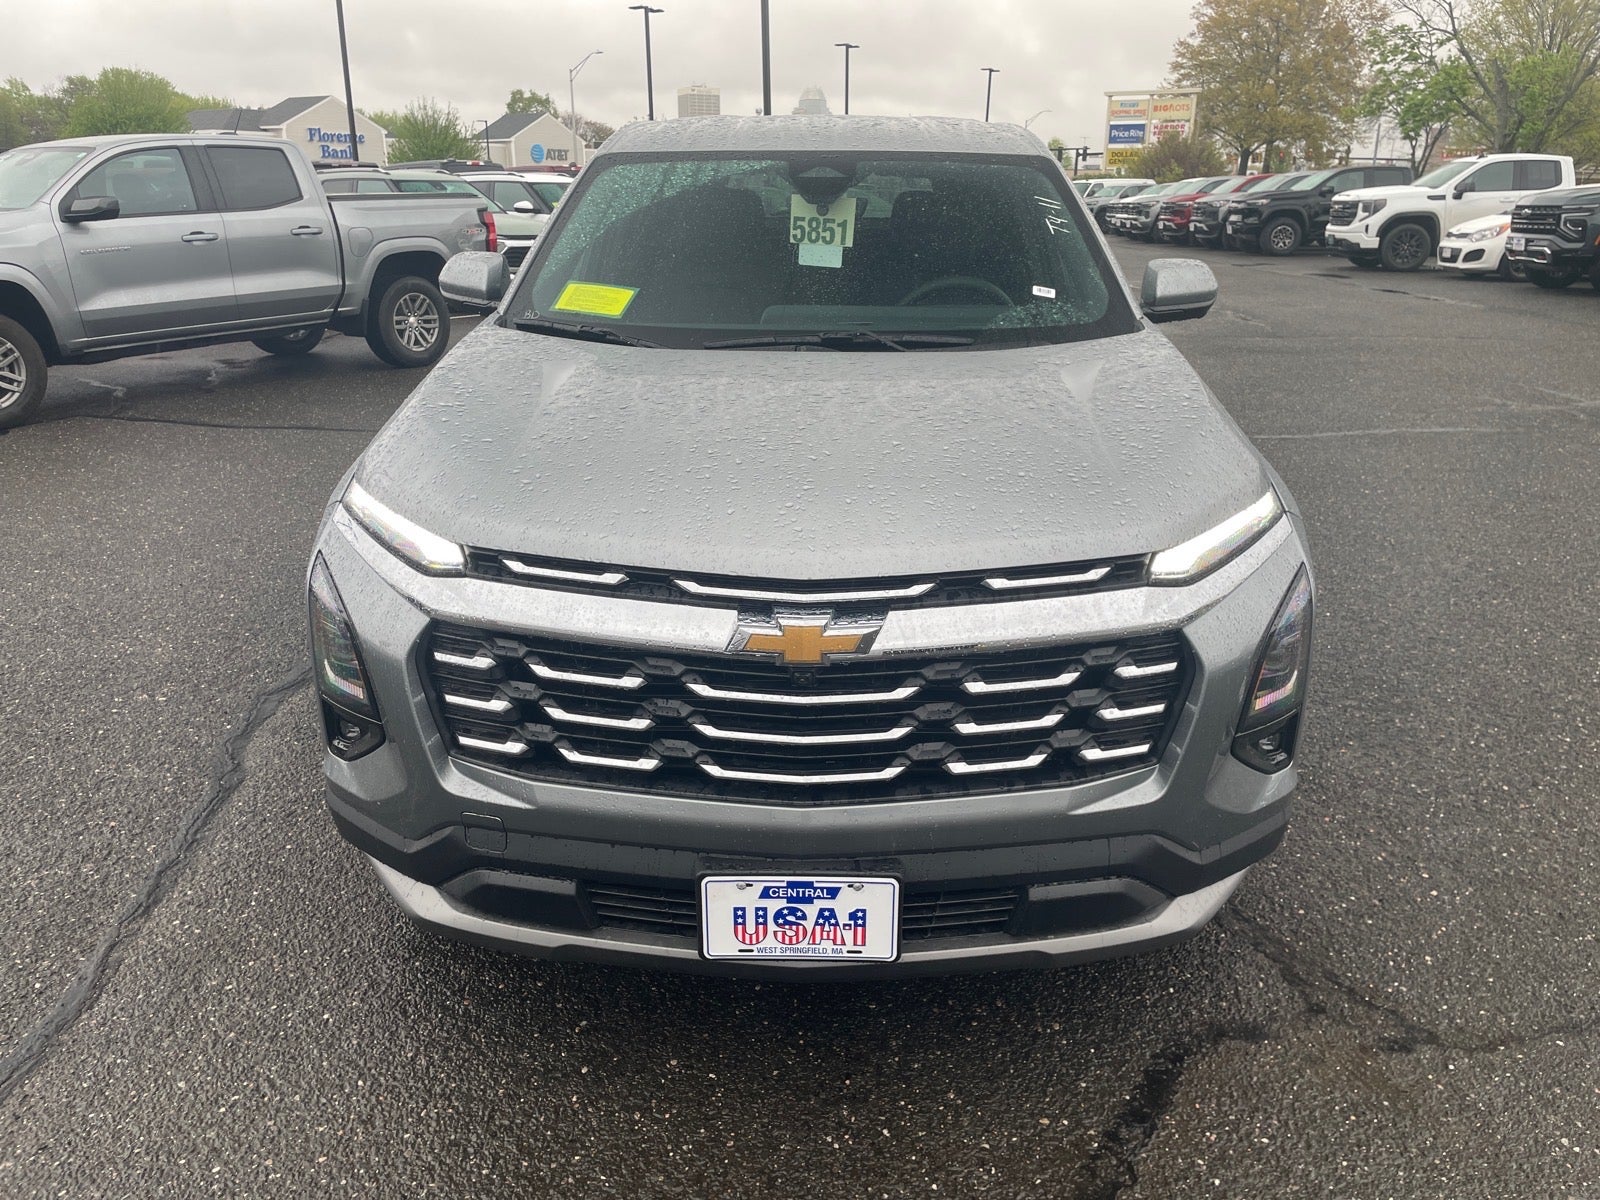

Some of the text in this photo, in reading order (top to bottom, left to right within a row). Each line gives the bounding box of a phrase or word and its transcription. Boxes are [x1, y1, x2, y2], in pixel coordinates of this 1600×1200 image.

[307, 127, 365, 144] Florene
[546, 148, 570, 161] AT&T
[792, 216, 848, 245] 5851
[769, 888, 832, 898] CENTRAL
[780, 946, 829, 955] SPRINGFIELD,
[831, 947, 844, 955] MA
